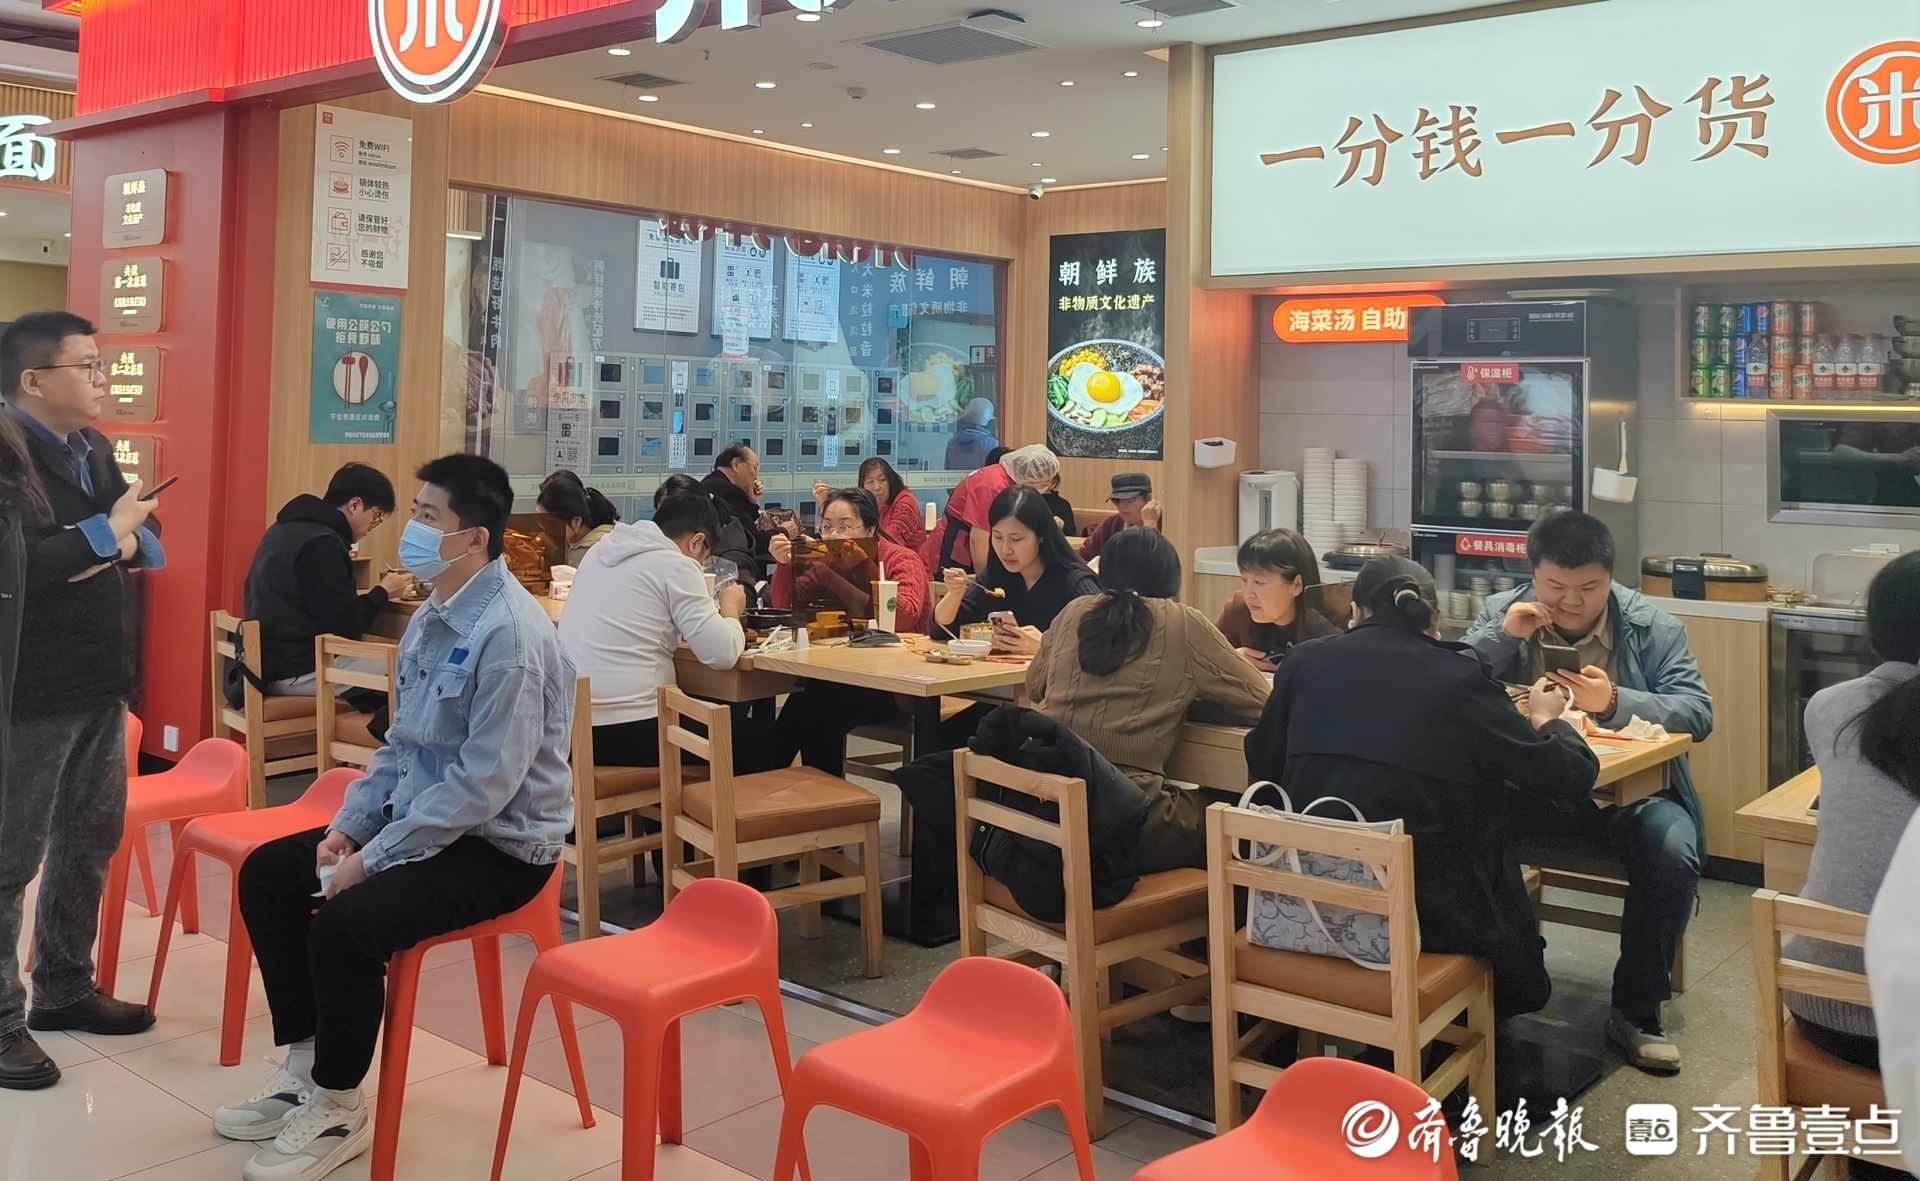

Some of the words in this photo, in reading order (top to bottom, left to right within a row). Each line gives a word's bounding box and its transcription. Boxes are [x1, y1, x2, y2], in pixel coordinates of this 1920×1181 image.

[1259, 73, 1776, 190] 一分钱一分货
[0, 114, 57, 182] 面
[359, 140, 390, 153] 免费WIFI
[359, 178, 390, 190] 锅体较热
[359, 188, 390, 200] 小心烫伤
[357, 213, 389, 225] 请保管好
[357, 223, 389, 235] 您的财物
[360, 249, 384, 260] 感谢您
[360, 259, 384, 270] 不吸烟
[1058, 257, 1156, 286] 朝鲜族
[1058, 293, 1155, 311] 非物质文化遗产
[326, 317, 392, 333] 使用公筷公勺
[1289, 307, 1356, 332] 海菜汤
[1361, 305, 1407, 331] 自助
[335, 331, 381, 346] 拒食野味
[1479, 367, 1513, 379] 保温柜
[1472, 539, 1527, 554] 餐具消毒柜
